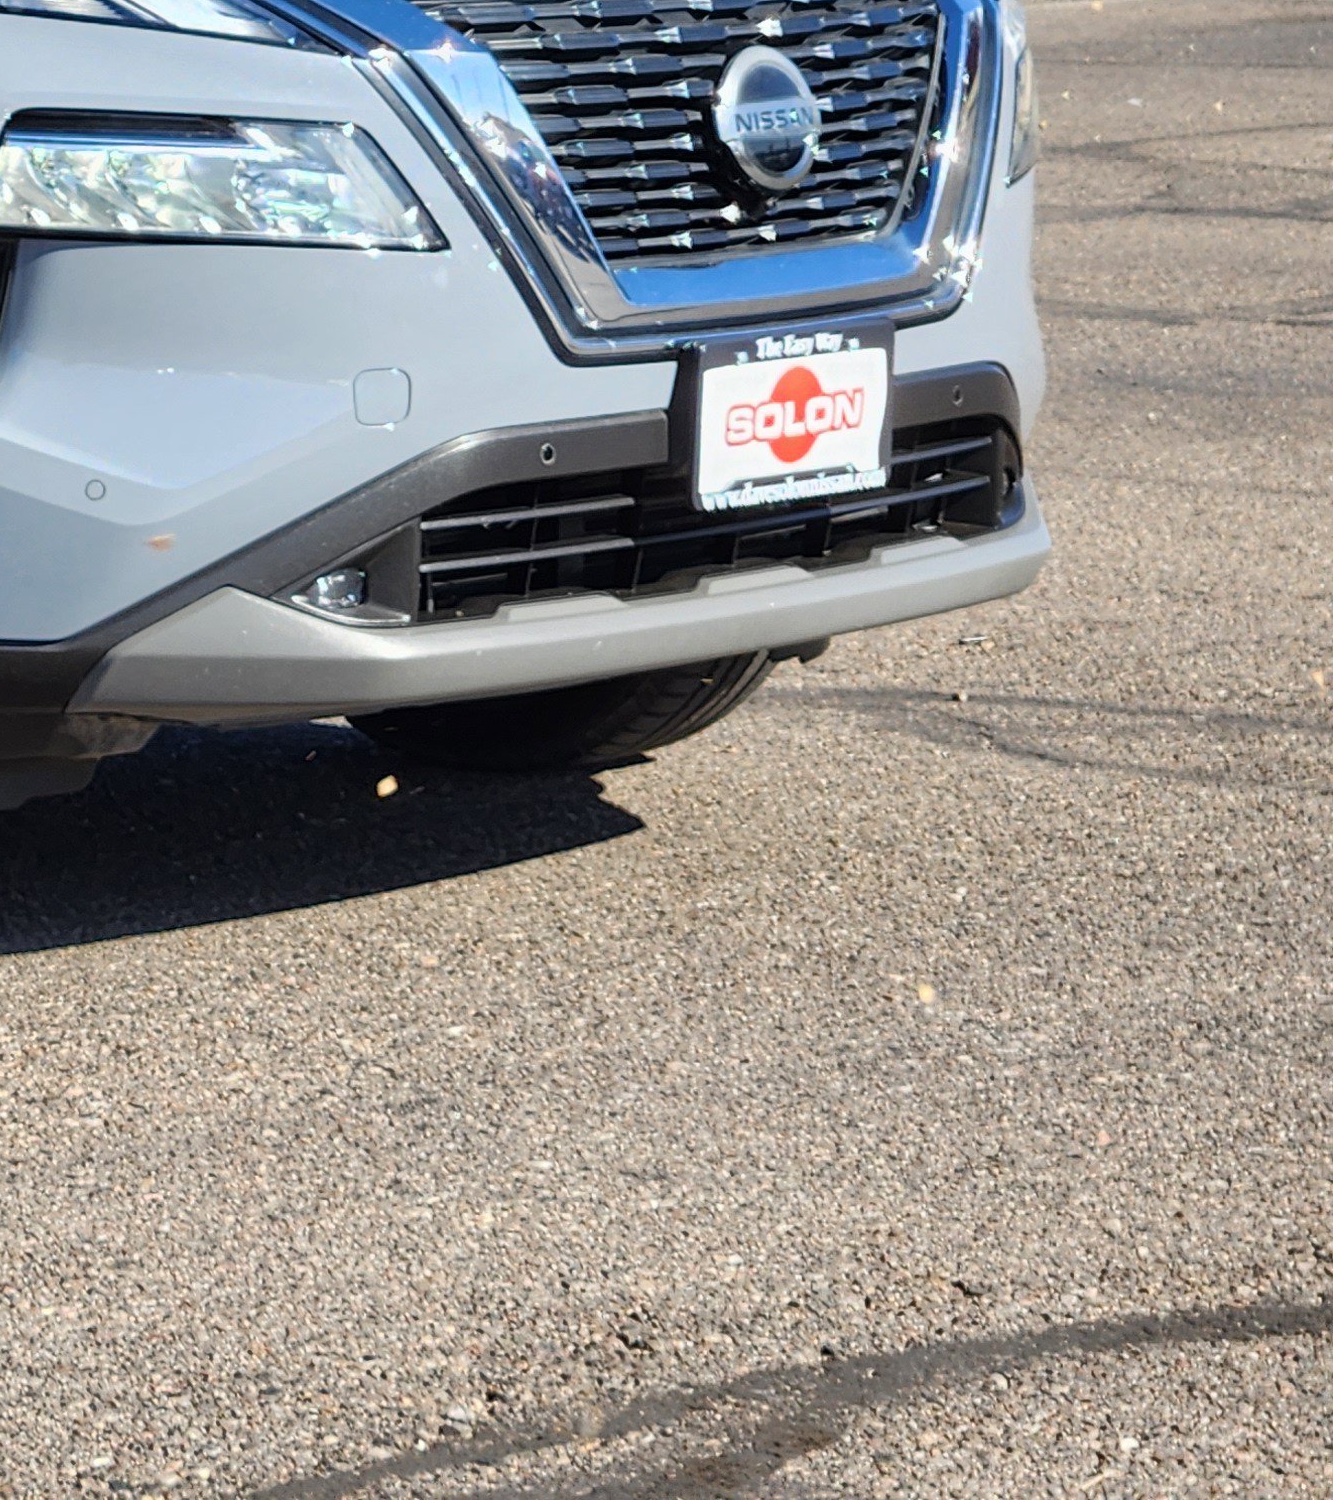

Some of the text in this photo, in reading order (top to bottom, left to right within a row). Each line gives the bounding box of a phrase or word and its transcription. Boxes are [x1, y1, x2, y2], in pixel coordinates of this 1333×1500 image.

[734, 106, 814, 132] NISSAN
[755, 332, 844, 360] The Easy Way
[725, 387, 864, 446] SOLON
